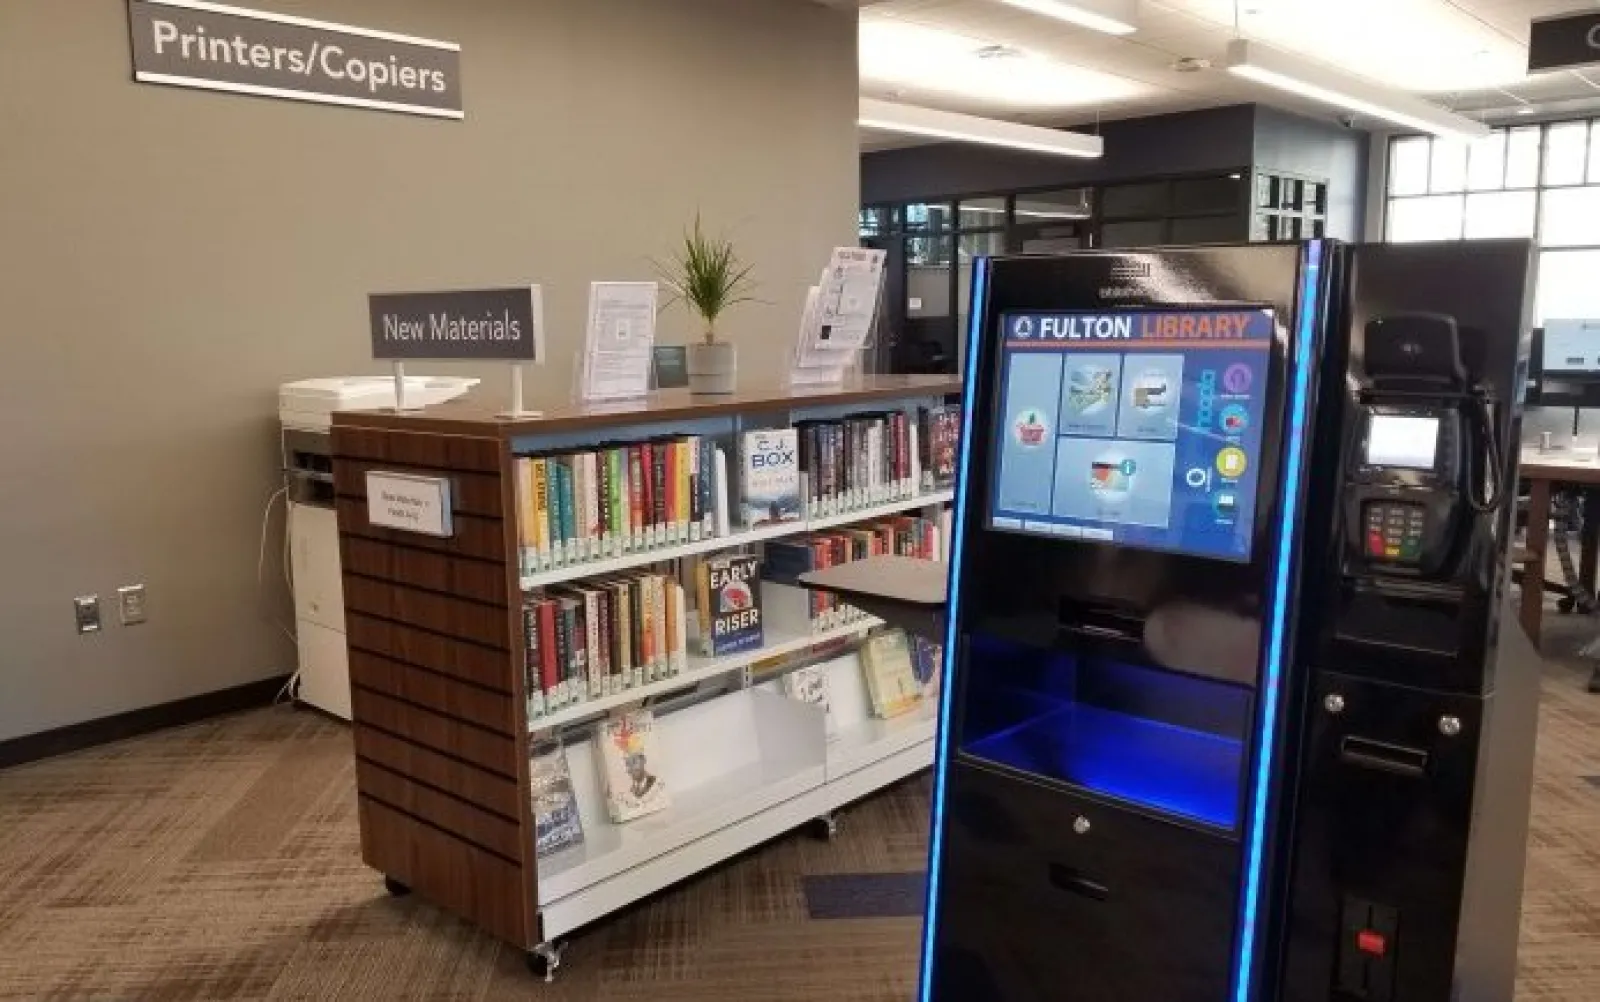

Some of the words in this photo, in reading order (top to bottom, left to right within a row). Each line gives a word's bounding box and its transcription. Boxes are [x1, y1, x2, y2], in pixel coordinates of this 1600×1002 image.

[152, 20, 447, 94] Printers/Copiers
[383, 313, 424, 341] New
[429, 307, 521, 341] Materials
[1040, 316, 1132, 339] FULTON
[1142, 314, 1251, 338] LIBRARY
[752, 450, 795, 469] BOX
[711, 561, 757, 589] EARLY
[716, 609, 757, 636] RISER
